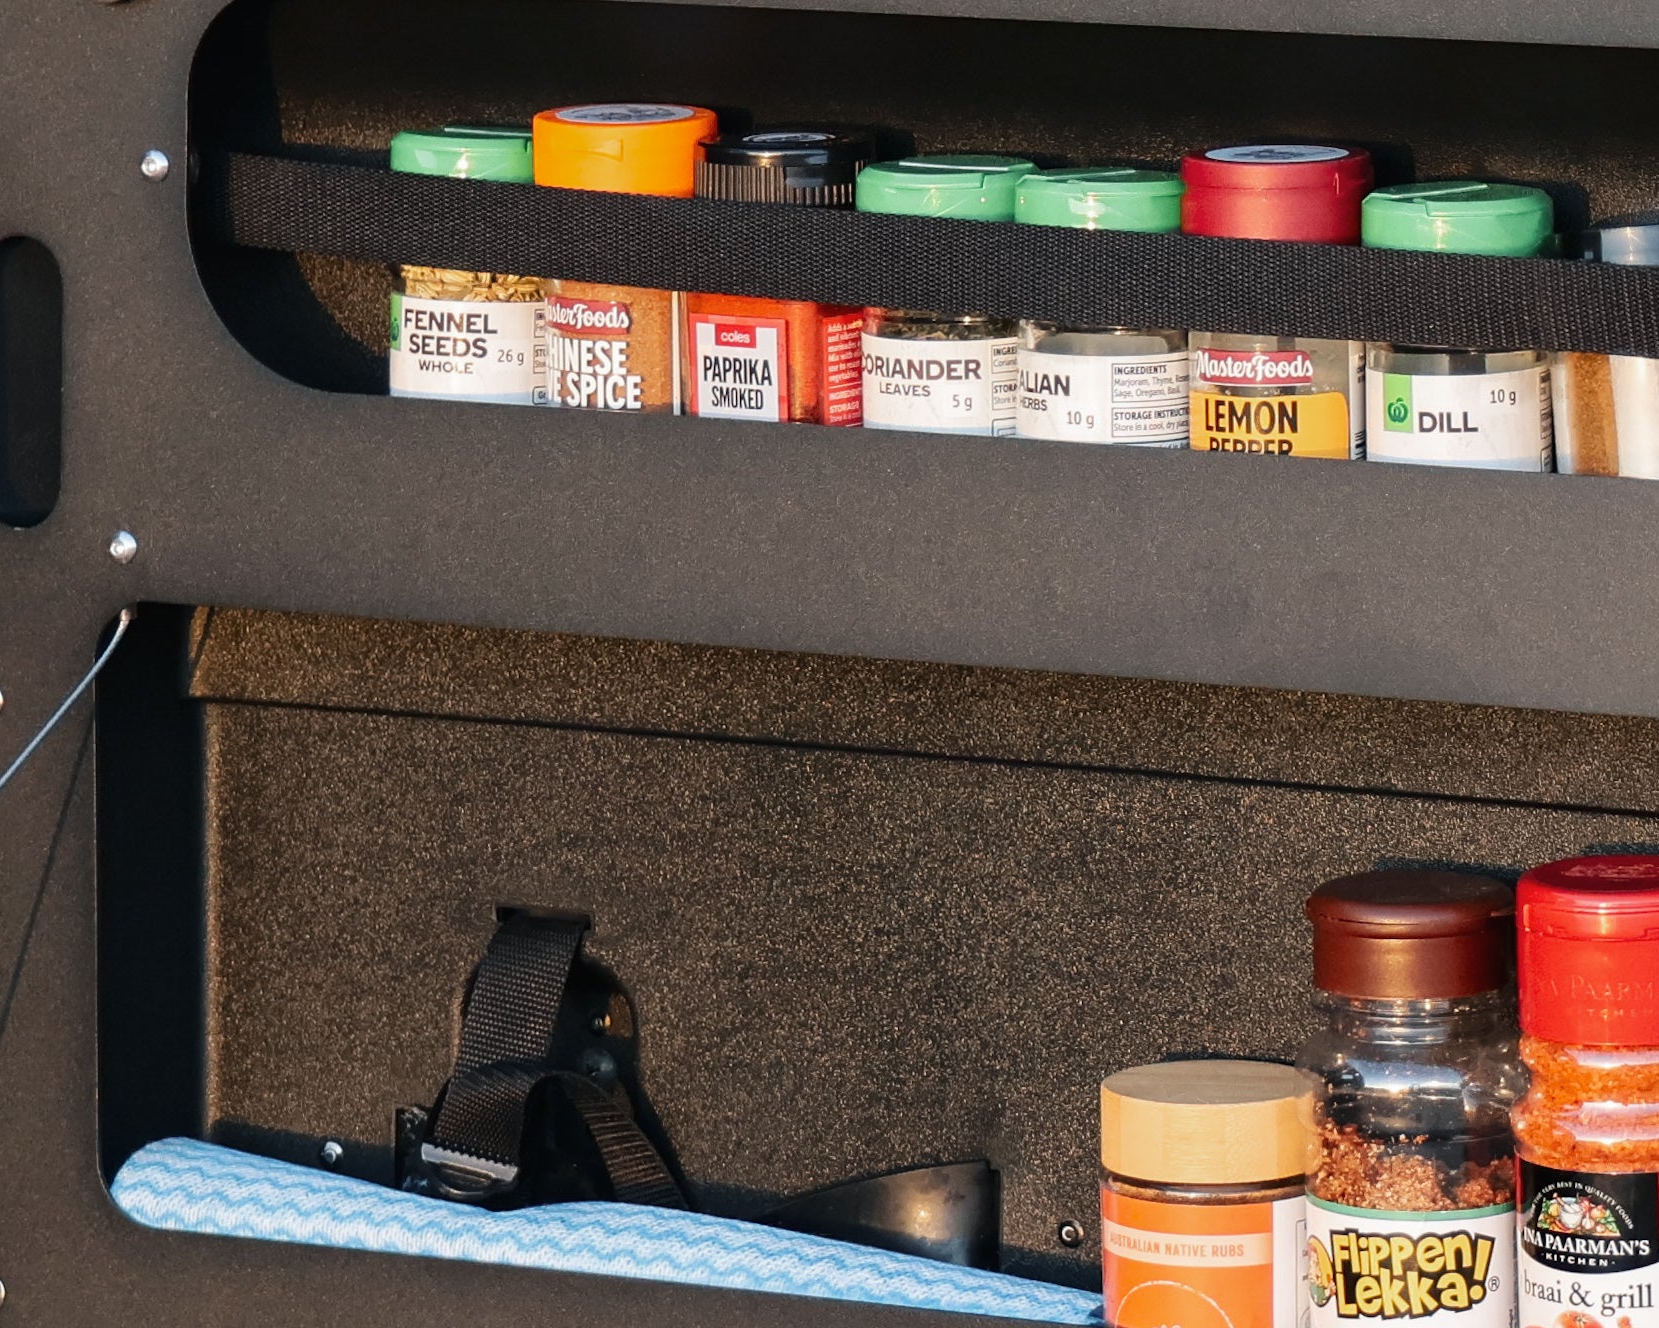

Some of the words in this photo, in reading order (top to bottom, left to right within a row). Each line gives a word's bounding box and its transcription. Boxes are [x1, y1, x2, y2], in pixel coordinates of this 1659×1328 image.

[404, 308, 498, 334] FENNEL
[546, 303, 629, 329] asterFoods
[409, 333, 488, 358] SEEDS
[721, 331, 750, 344] coles
[497, 349, 513, 363] 26
[517, 352, 525, 366] g
[547, 334, 627, 374] HINESE
[1196, 350, 1313, 381] MasterFoods
[418, 359, 474, 374] WHOLE
[703, 355, 773, 386] PAPRIKA
[1114, 365, 1167, 375] INGREDIENTS
[566, 372, 642, 409] SPICE
[879, 382, 931, 397] LEAVES
[1018, 370, 1070, 396] ALIAN
[711, 386, 763, 409] SMOKED
[952, 394, 960, 408] 5
[964, 397, 972, 411] g
[1490, 389, 1505, 404] 10
[1509, 390, 1516, 405] g
[1067, 411, 1082, 425] 10
[1086, 415, 1094, 429] g
[1114, 411, 1152, 420] STORAGE
[1205, 398, 1298, 435] LEMON
[1418, 411, 1479, 433] DILL
[1110, 1233, 1160, 1254] AUSTRALIAN
[1165, 1243, 1207, 1257] NATIVE
[1211, 1244, 1244, 1257] RUBS
[1524, 1226, 1543, 1247] INA
[1545, 1233, 1650, 1256] PAARMAN'S
[1331, 1232, 1473, 1276] Flippen
[1545, 1253, 1608, 1267] KITCHEN
[1524, 1269, 1562, 1303] braai
[1569, 1282, 1594, 1307] &
[1601, 1283, 1654, 1316] grill
